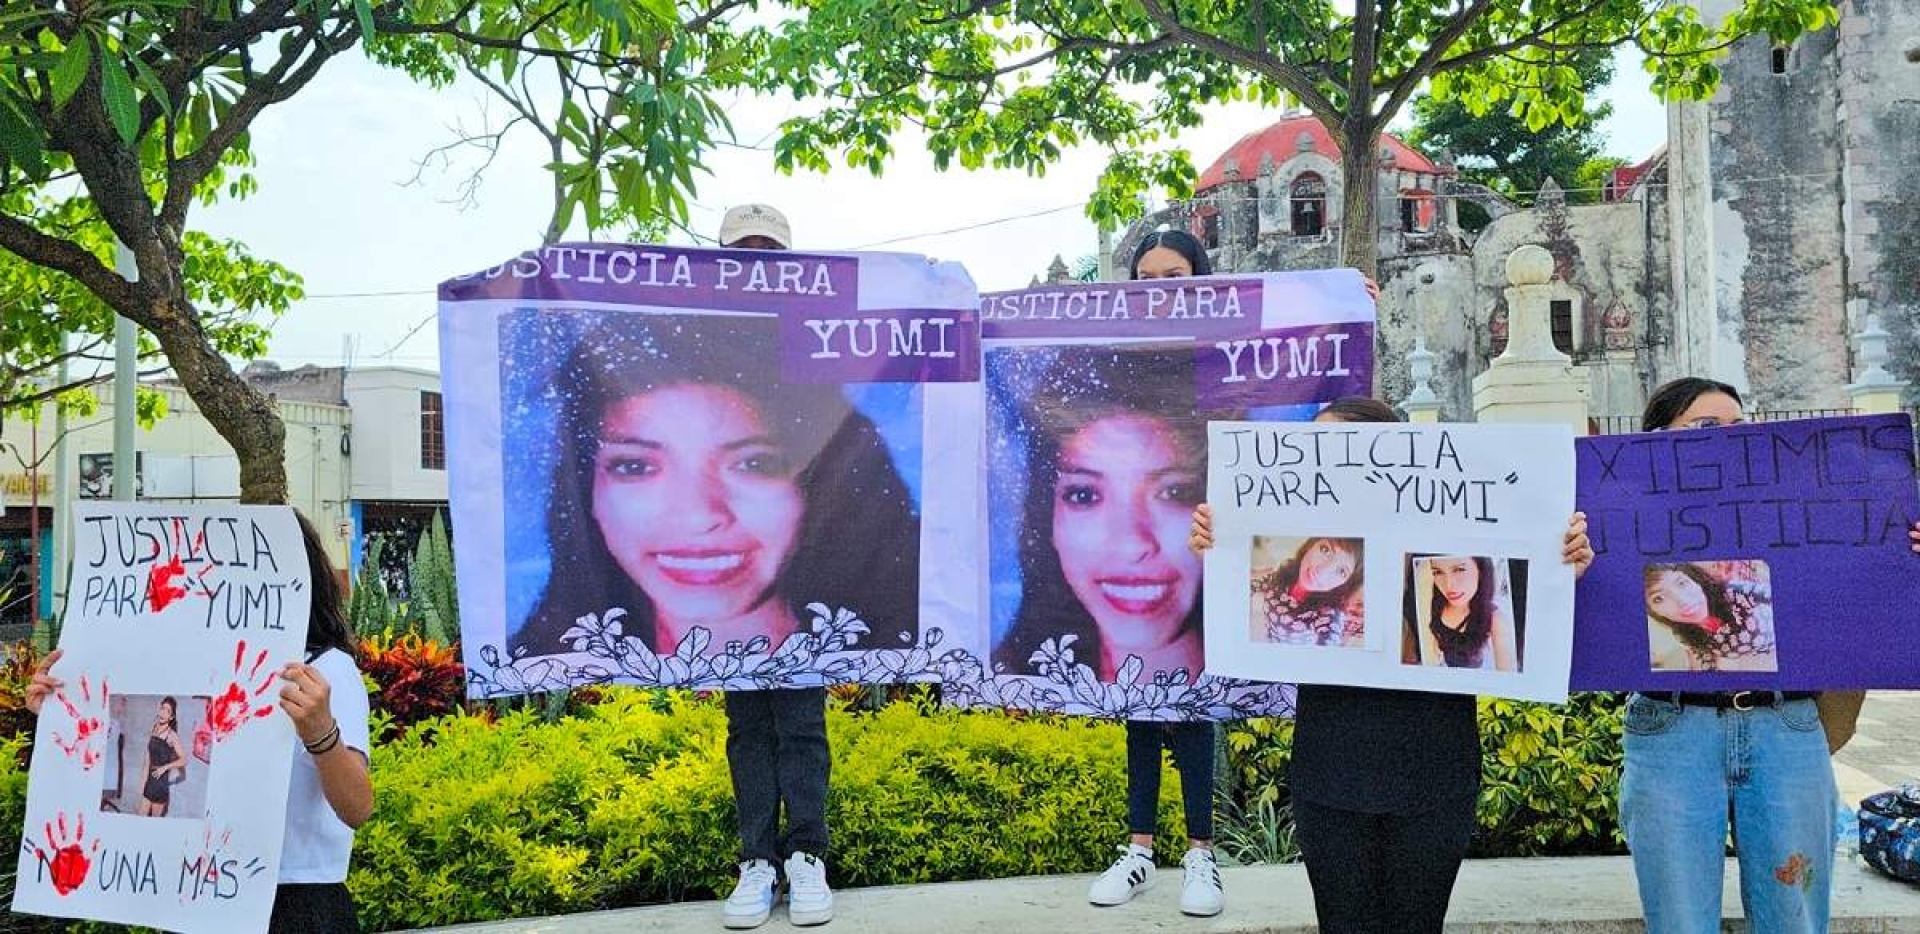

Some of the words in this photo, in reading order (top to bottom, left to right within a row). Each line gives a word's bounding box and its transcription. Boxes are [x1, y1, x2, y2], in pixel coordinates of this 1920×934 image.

[714, 258, 837, 296] PARA
[1145, 285, 1245, 320] PARA
[803, 317, 956, 360] YUMI
[1216, 333, 1350, 384] YUMI
[1222, 429, 1464, 472] JUSTICIA
[1234, 471, 1340, 507] PARA
[1364, 471, 1520, 524] "YUMI"
[84, 514, 279, 573] JUSTICIA
[1594, 496, 1909, 556] JUSTICIA
[82, 573, 161, 618] PARA
[183, 576, 303, 631] "YUMI"
[98, 849, 158, 895] UNA
